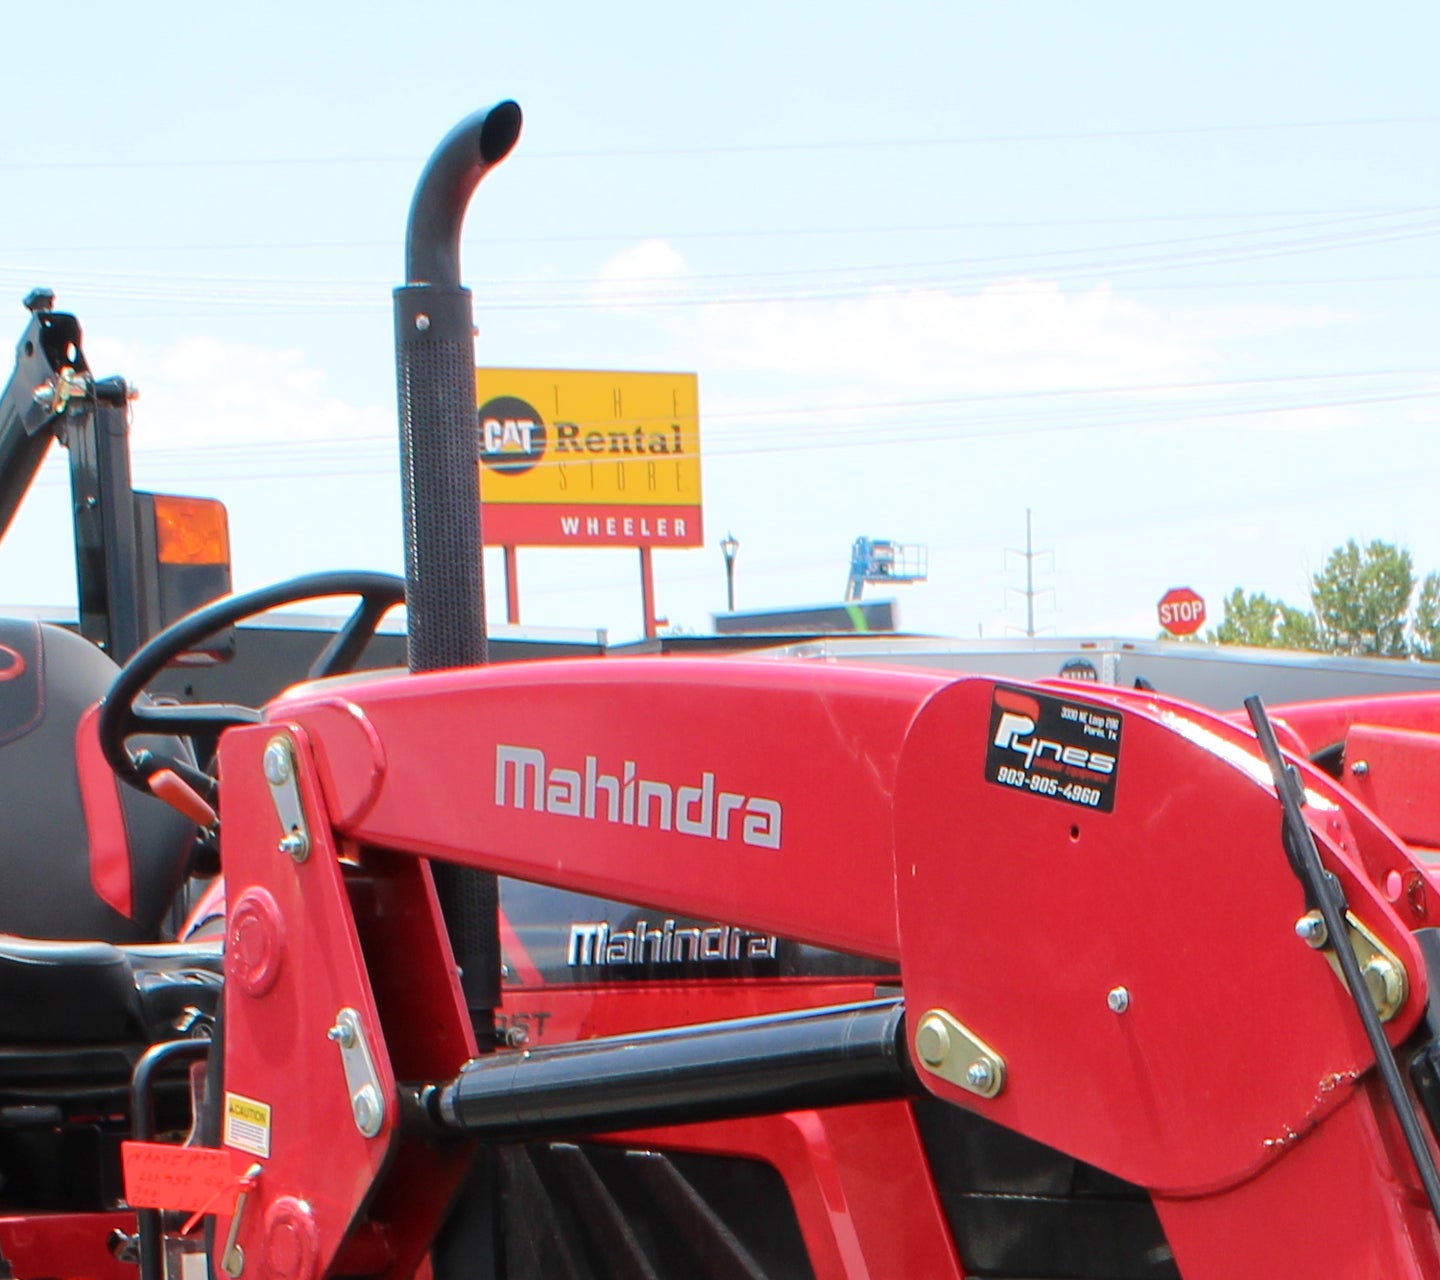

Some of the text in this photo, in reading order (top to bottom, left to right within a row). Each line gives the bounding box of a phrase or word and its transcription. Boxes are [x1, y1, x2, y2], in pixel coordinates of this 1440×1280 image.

[554, 385, 679, 419] THE
[483, 418, 535, 454] CAT
[554, 421, 685, 455] Rental
[558, 460, 683, 492] STORE
[561, 517, 687, 537] WHEELER
[1160, 601, 1203, 624] STOP
[994, 711, 1116, 774] Pynes
[495, 744, 782, 850] Mahindra
[997, 766, 1101, 807] 903-905-4960
[567, 919, 778, 967] Mahindra
[234, 1102, 266, 1123] CAUTION
